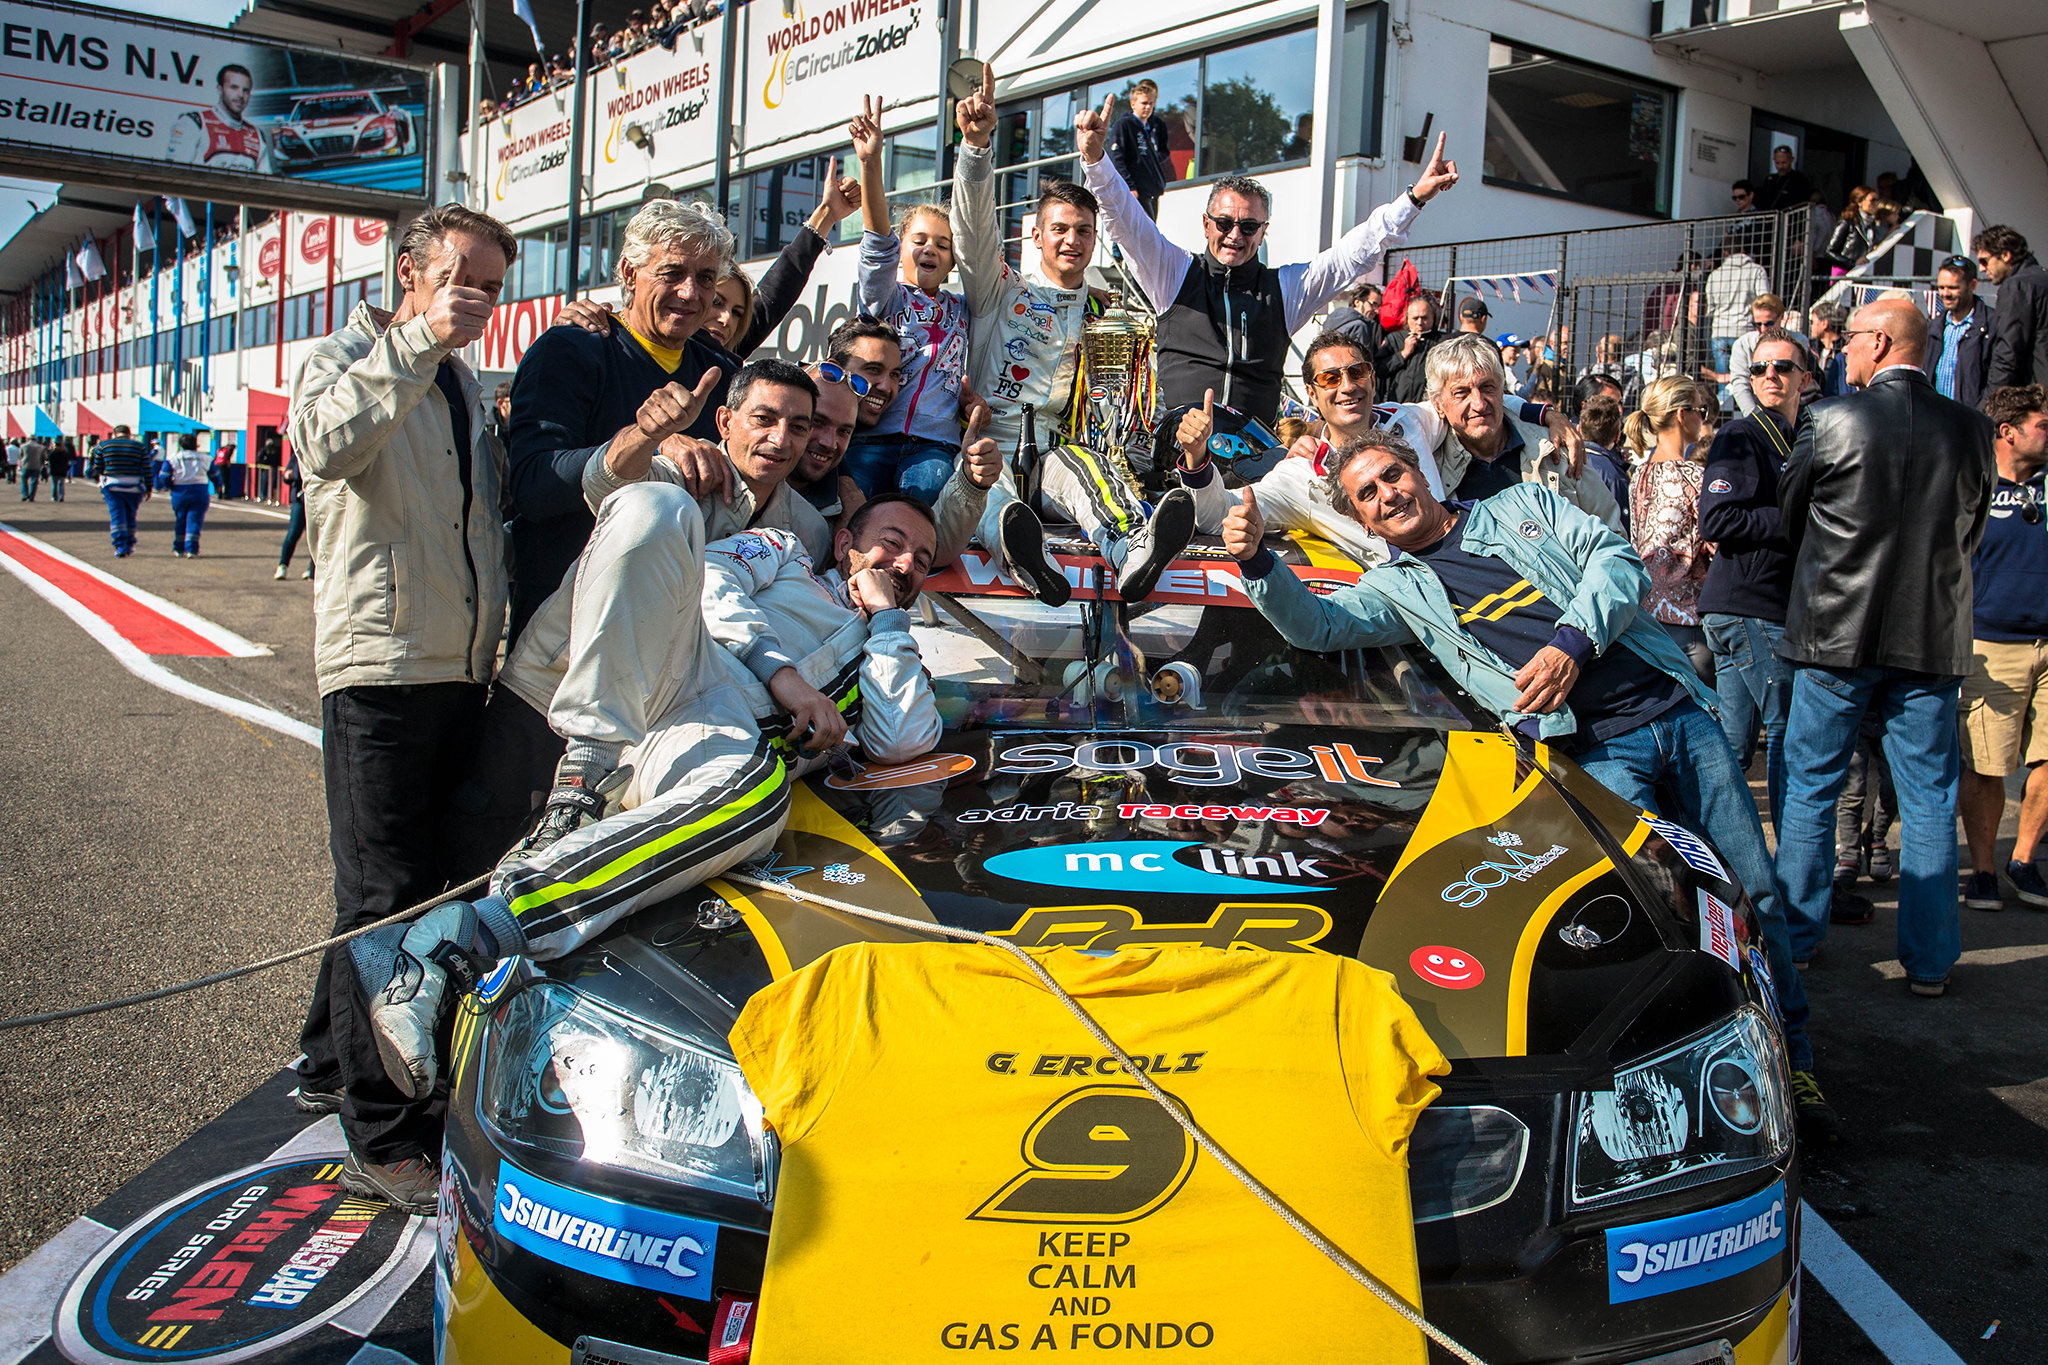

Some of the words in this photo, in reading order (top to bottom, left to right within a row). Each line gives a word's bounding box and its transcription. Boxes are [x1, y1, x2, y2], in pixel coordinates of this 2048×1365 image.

[768, 16, 820, 56] WORLD
[824, 5, 846, 34] ON
[851, 0, 919, 24] WHEE
[3, 23, 109, 71] EMS
[125, 44, 203, 86] N.V.
[607, 90, 643, 119] WORLD
[645, 82, 660, 105] ON
[663, 62, 709, 98] WHEELS
[498, 139, 524, 163] WORLD
[525, 135, 537, 153] ON
[538, 118, 571, 147] WHEELS
[1000, 740, 1401, 789] sogeit
[956, 801, 1103, 824] adria
[1119, 803, 1330, 827] raceway
[1065, 850, 1163, 872] mc
[1200, 848, 1329, 879] link
[985, 1052, 1020, 1076] G.
[1030, 1051, 1208, 1077] ERCOLI
[965, 1084, 1199, 1225] 9
[206, 1185, 268, 1230] EURO
[125, 1233, 215, 1300] SERIES
[147, 1184, 343, 1321] WHELEN
[250, 1228, 362, 1305] NASCAR
[1038, 1232, 1131, 1257] KEEP
[1028, 1264, 1136, 1289] CALM
[1048, 1296, 1111, 1316] AND
[941, 1322, 1020, 1350] GAS
[1031, 1323, 1058, 1350] A
[1070, 1322, 1214, 1350] FONDO
